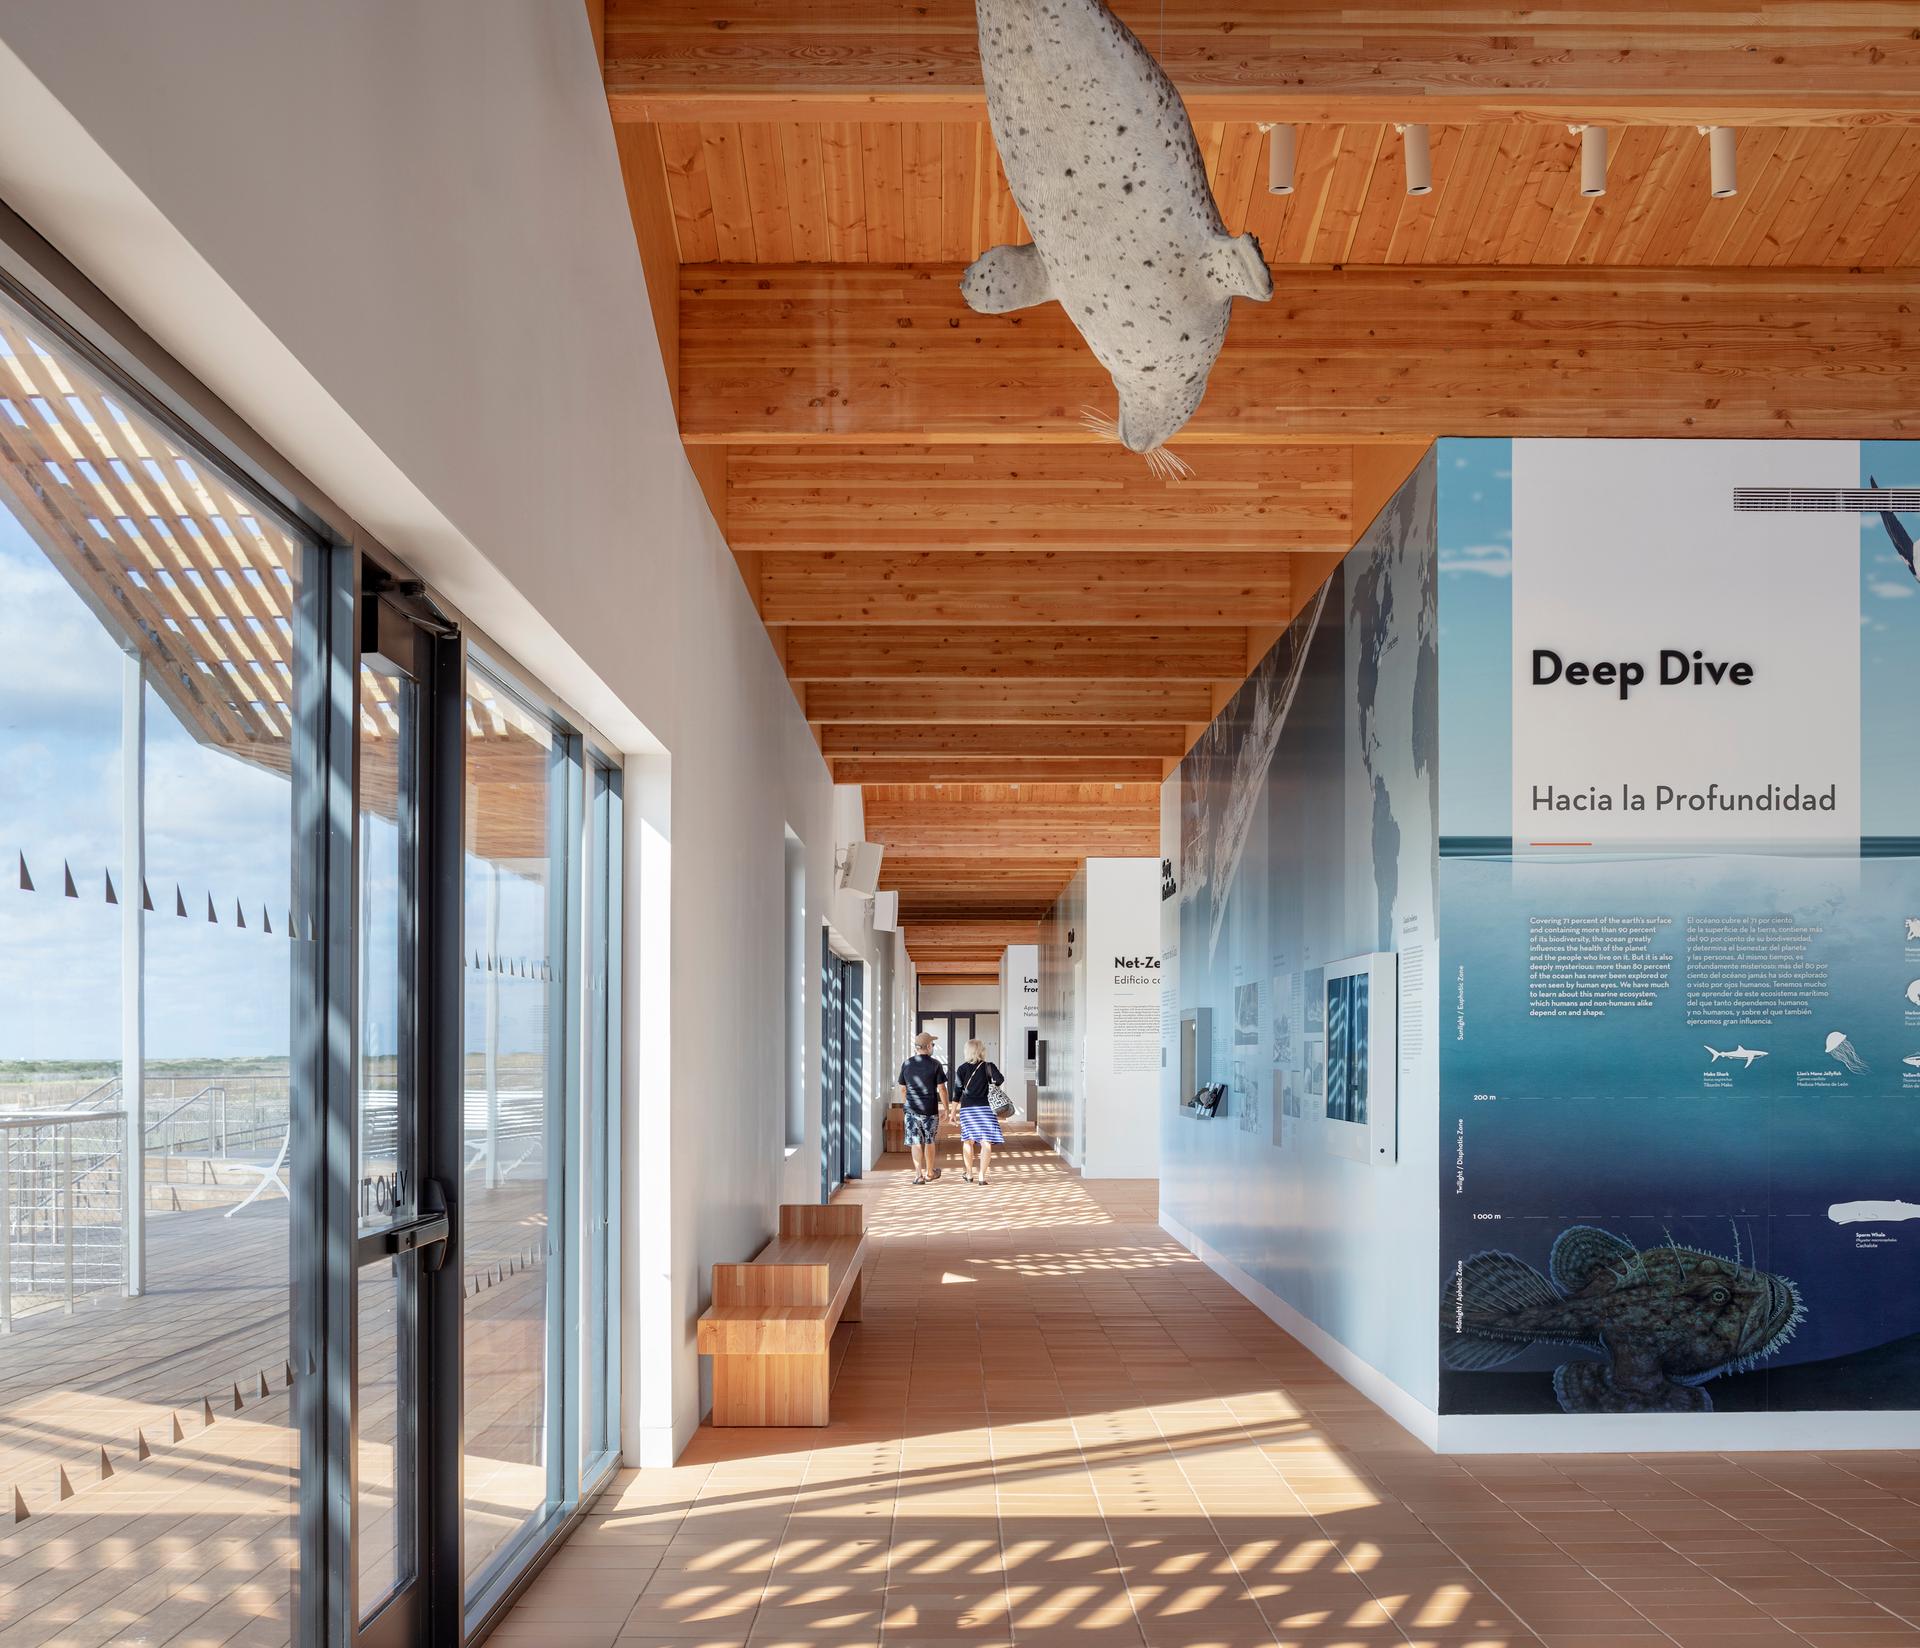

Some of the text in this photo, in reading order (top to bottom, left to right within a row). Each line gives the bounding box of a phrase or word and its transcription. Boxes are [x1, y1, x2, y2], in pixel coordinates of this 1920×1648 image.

[1532, 649, 1754, 700] Deep Dive
[1532, 784, 1836, 811] Hacia la Profundidad
[1530, 916, 1561, 926] Covering
[1571, 916, 1598, 926] percent
[1544, 926, 1580, 935] containing
[1629, 926, 1656, 935] percent
[1549, 935, 1590, 944] biodiversity,
[1627, 935, 1651, 944] greatly
[1625, 944, 1647, 953] planet
[1557, 953, 1582, 962] people
[1530, 962, 1553, 971] deeply
[1555, 962, 1594, 971] mysterious:
[1643, 962, 1670, 971] percent
[1114, 975, 1149, 984] Edificio
[1628, 972, 1658, 980] explored
[1566, 981, 1574, 990] by
[1619, 990, 1657, 999] ecosystem,
[1530, 1008, 1556, 1017] depend
[1582, 1008, 1605, 1017] shape.
[1456, 1016, 1465, 1041] Sunlight
[358, 1170, 408, 1217] IT ONLY
